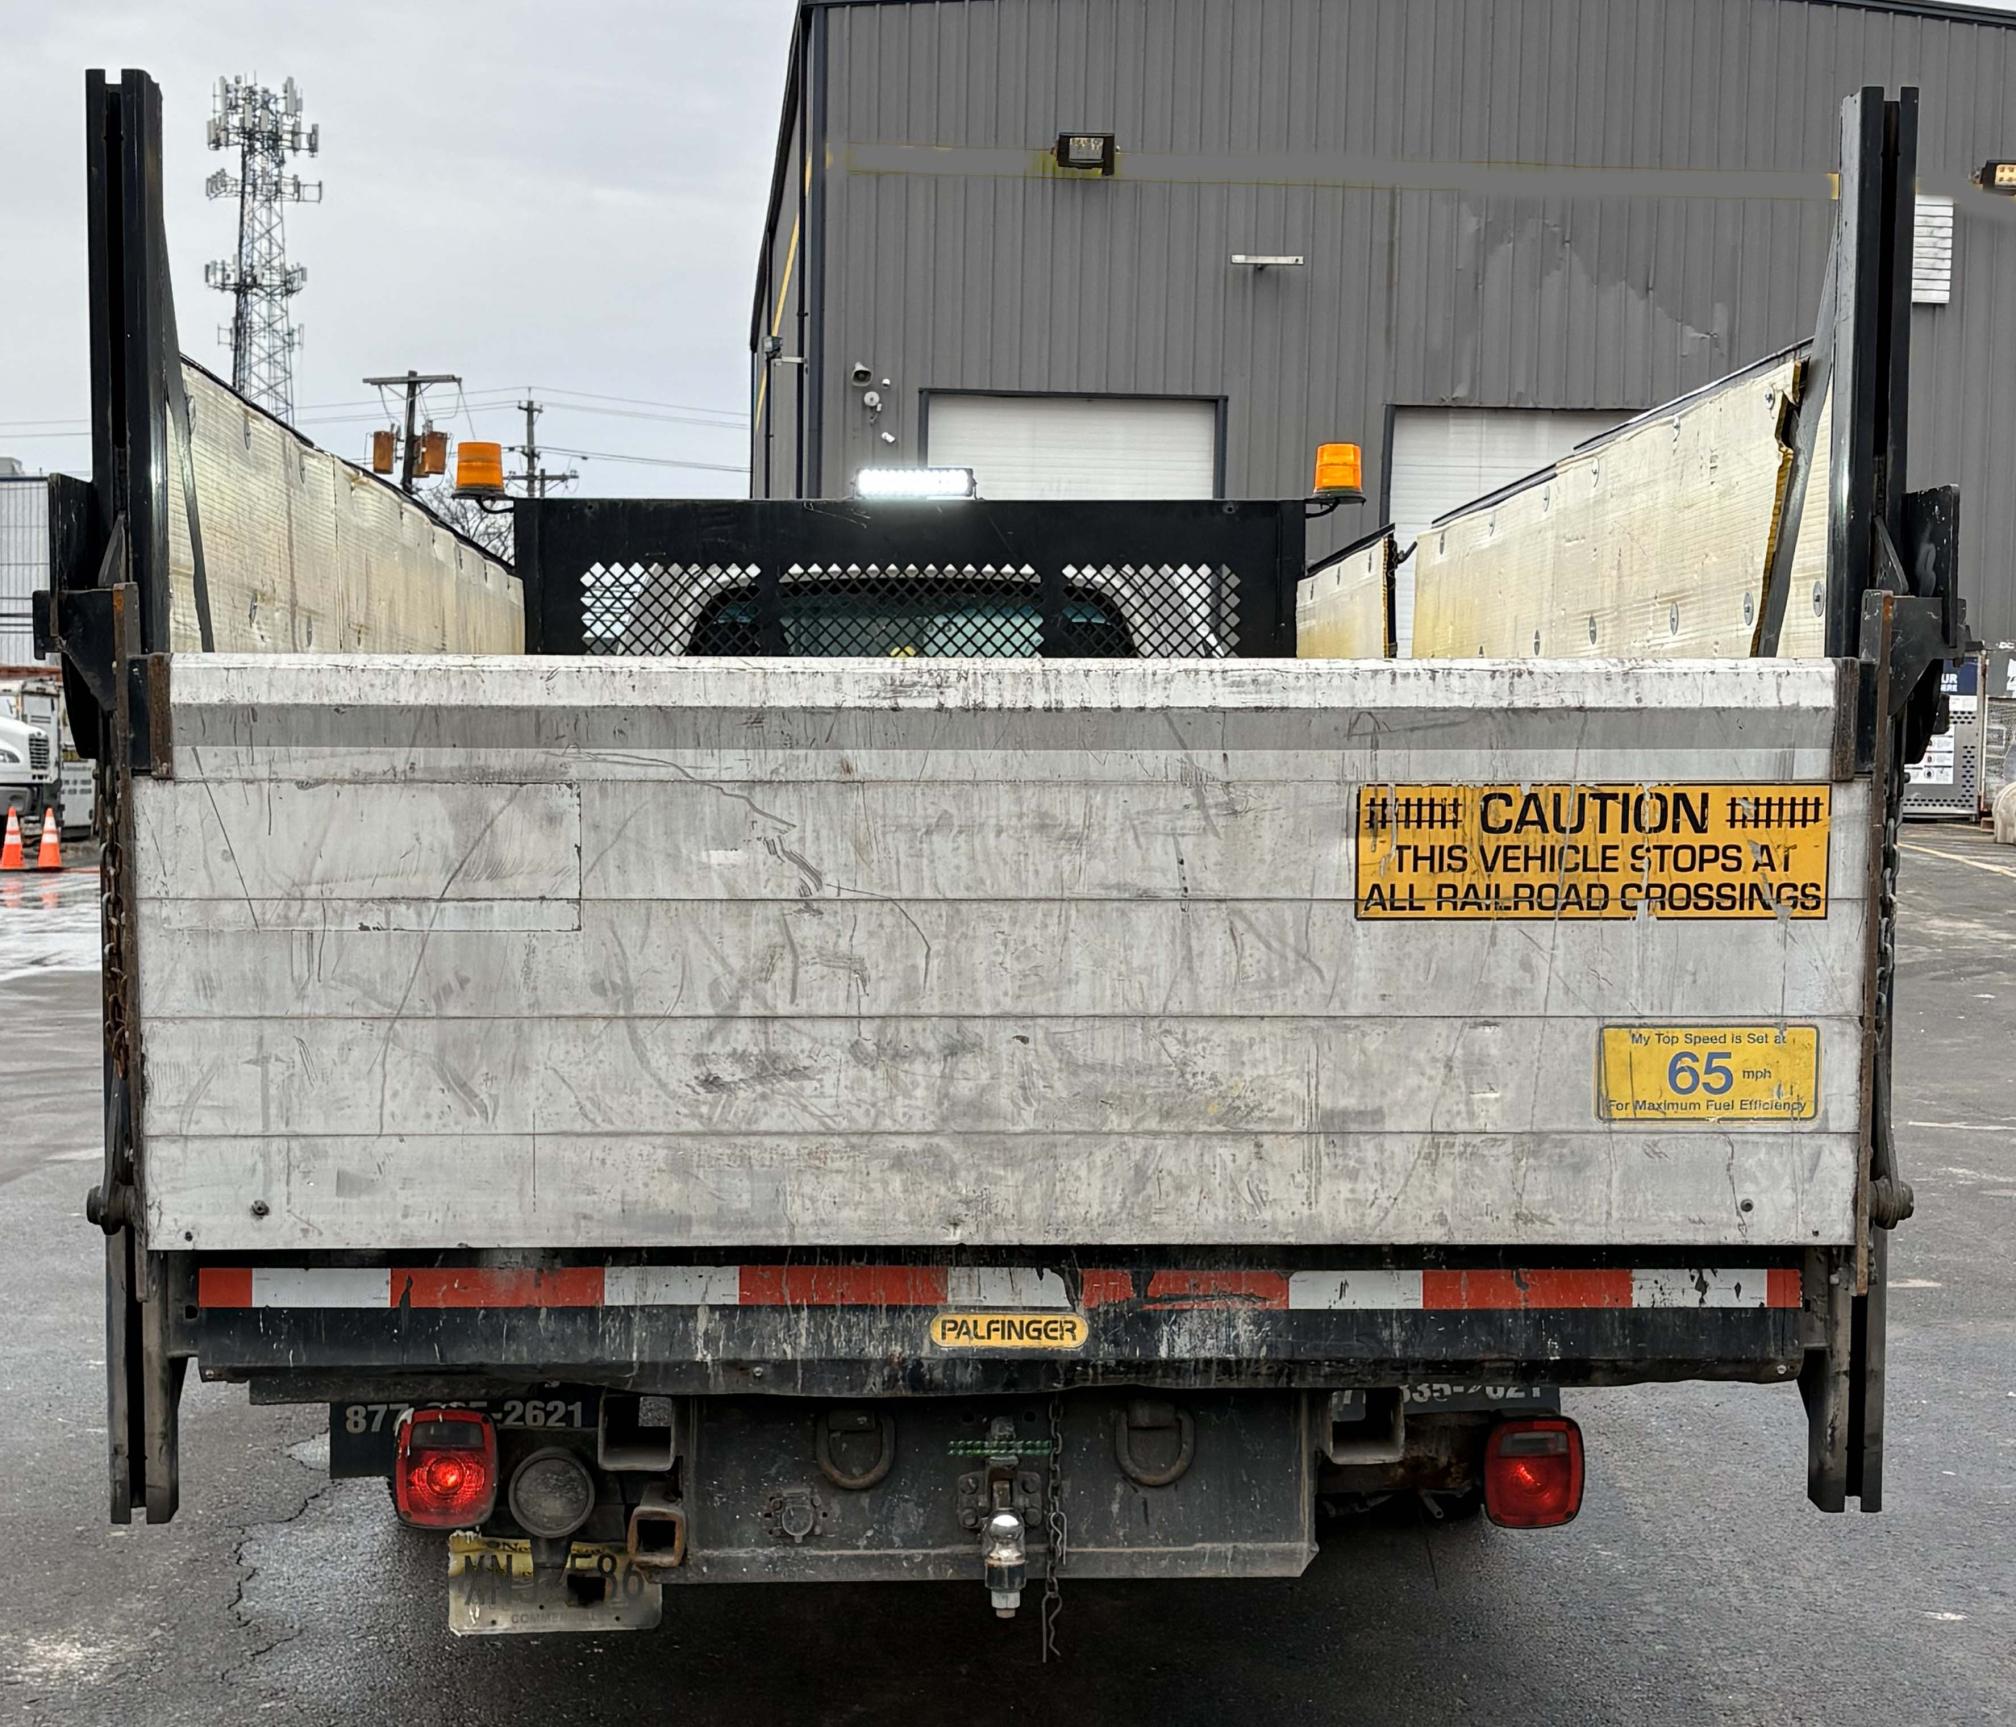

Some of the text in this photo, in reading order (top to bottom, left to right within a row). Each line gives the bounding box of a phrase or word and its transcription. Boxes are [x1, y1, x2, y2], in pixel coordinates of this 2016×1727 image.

[1480, 792, 1709, 835] CAUTION
[1396, 844, 1794, 873] THIS VEHICLE STOPS AT
[1364, 883, 1822, 912] ALL RAILROAD CROSSINGS
[1631, 1033, 1649, 1046] My
[1655, 1033, 1679, 1045] Top
[1684, 1033, 1727, 1045] Speed
[1731, 1033, 1742, 1044] is
[1747, 1033, 1768, 1044] Set
[1668, 1051, 1733, 1095] 65
[1742, 1068, 1771, 1079] mph
[1609, 1099, 1806, 1112] For Maximum Fuel Efficiency
[941, 1320, 1076, 1341] PALFINGER
